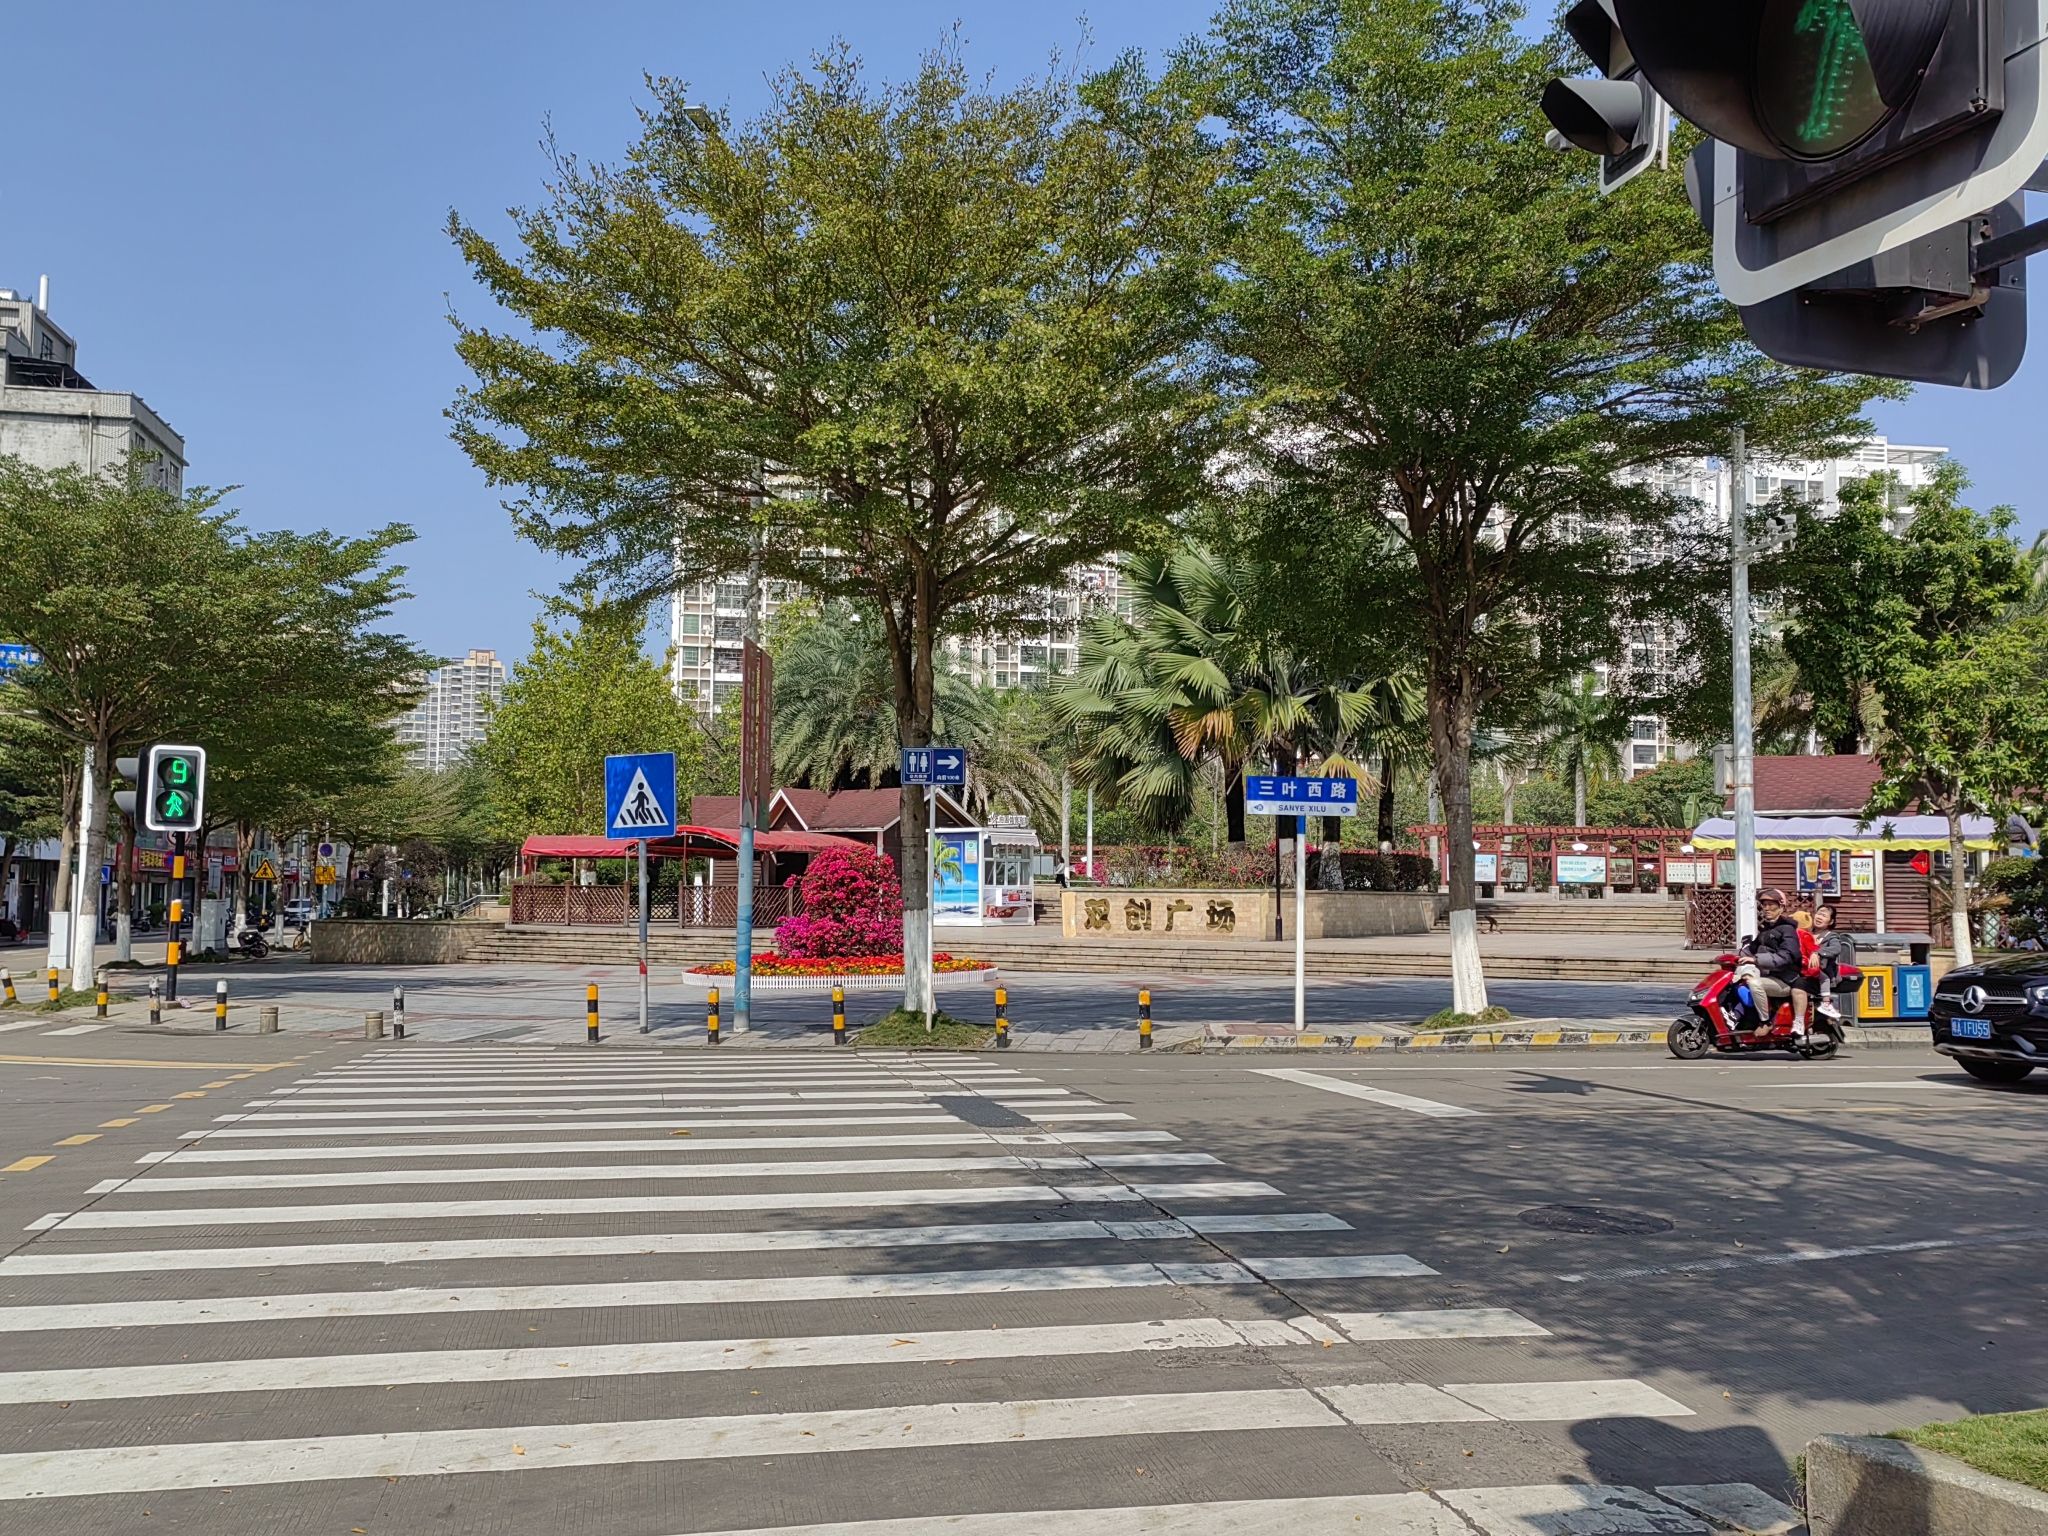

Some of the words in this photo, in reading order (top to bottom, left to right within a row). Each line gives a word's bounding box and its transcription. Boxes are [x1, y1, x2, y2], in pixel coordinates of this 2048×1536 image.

[172, 760, 187, 784] 9
[1258, 780, 1347, 799] 三叶西路
[1278, 804, 1305, 812] SANYE
[1308, 805, 1327, 813] XILU
[1083, 898, 1236, 933] 双创广场
